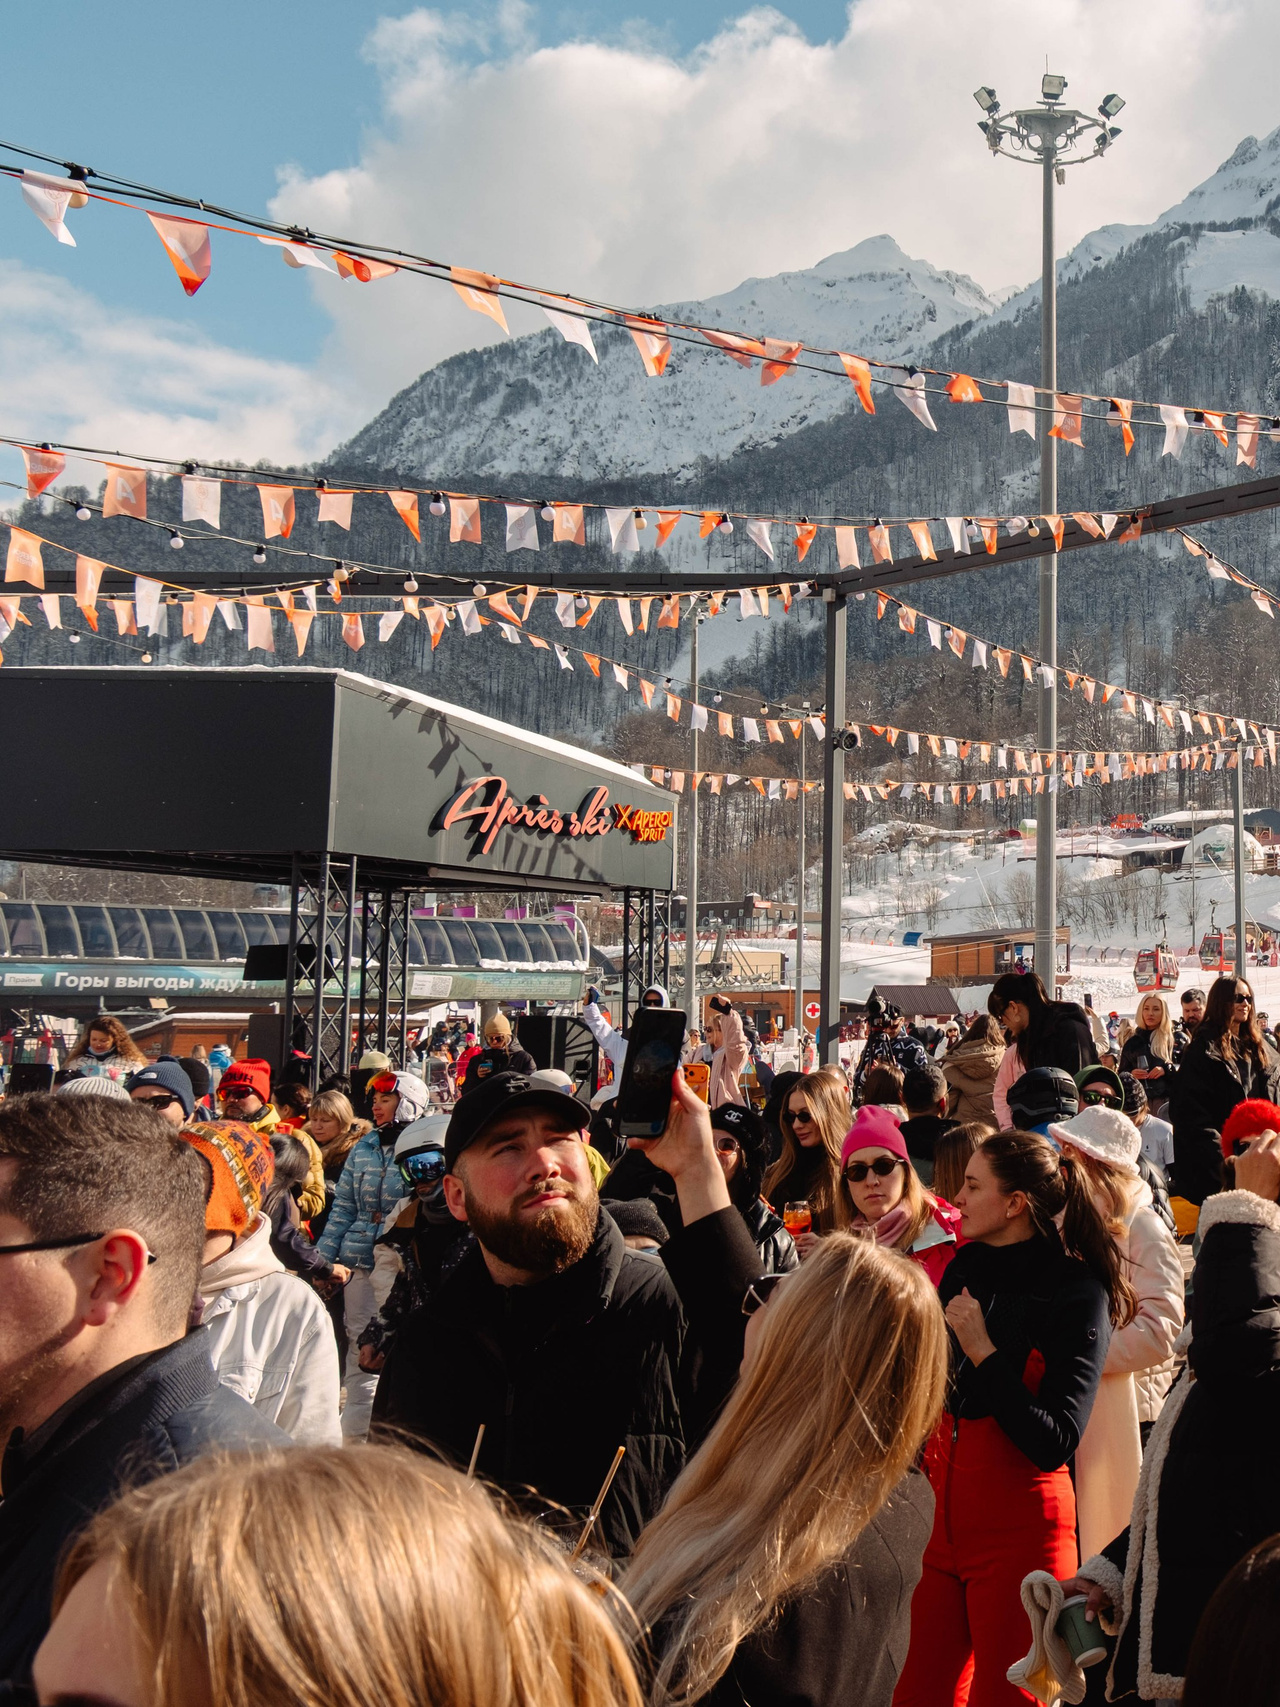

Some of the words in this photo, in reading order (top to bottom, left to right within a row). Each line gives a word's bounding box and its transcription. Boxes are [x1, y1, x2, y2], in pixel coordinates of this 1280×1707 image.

[570, 786, 612, 836] ski
[632, 809, 673, 830] APEROL
[54, 971, 109, 991] Горы
[114, 975, 195, 992] выгоды
